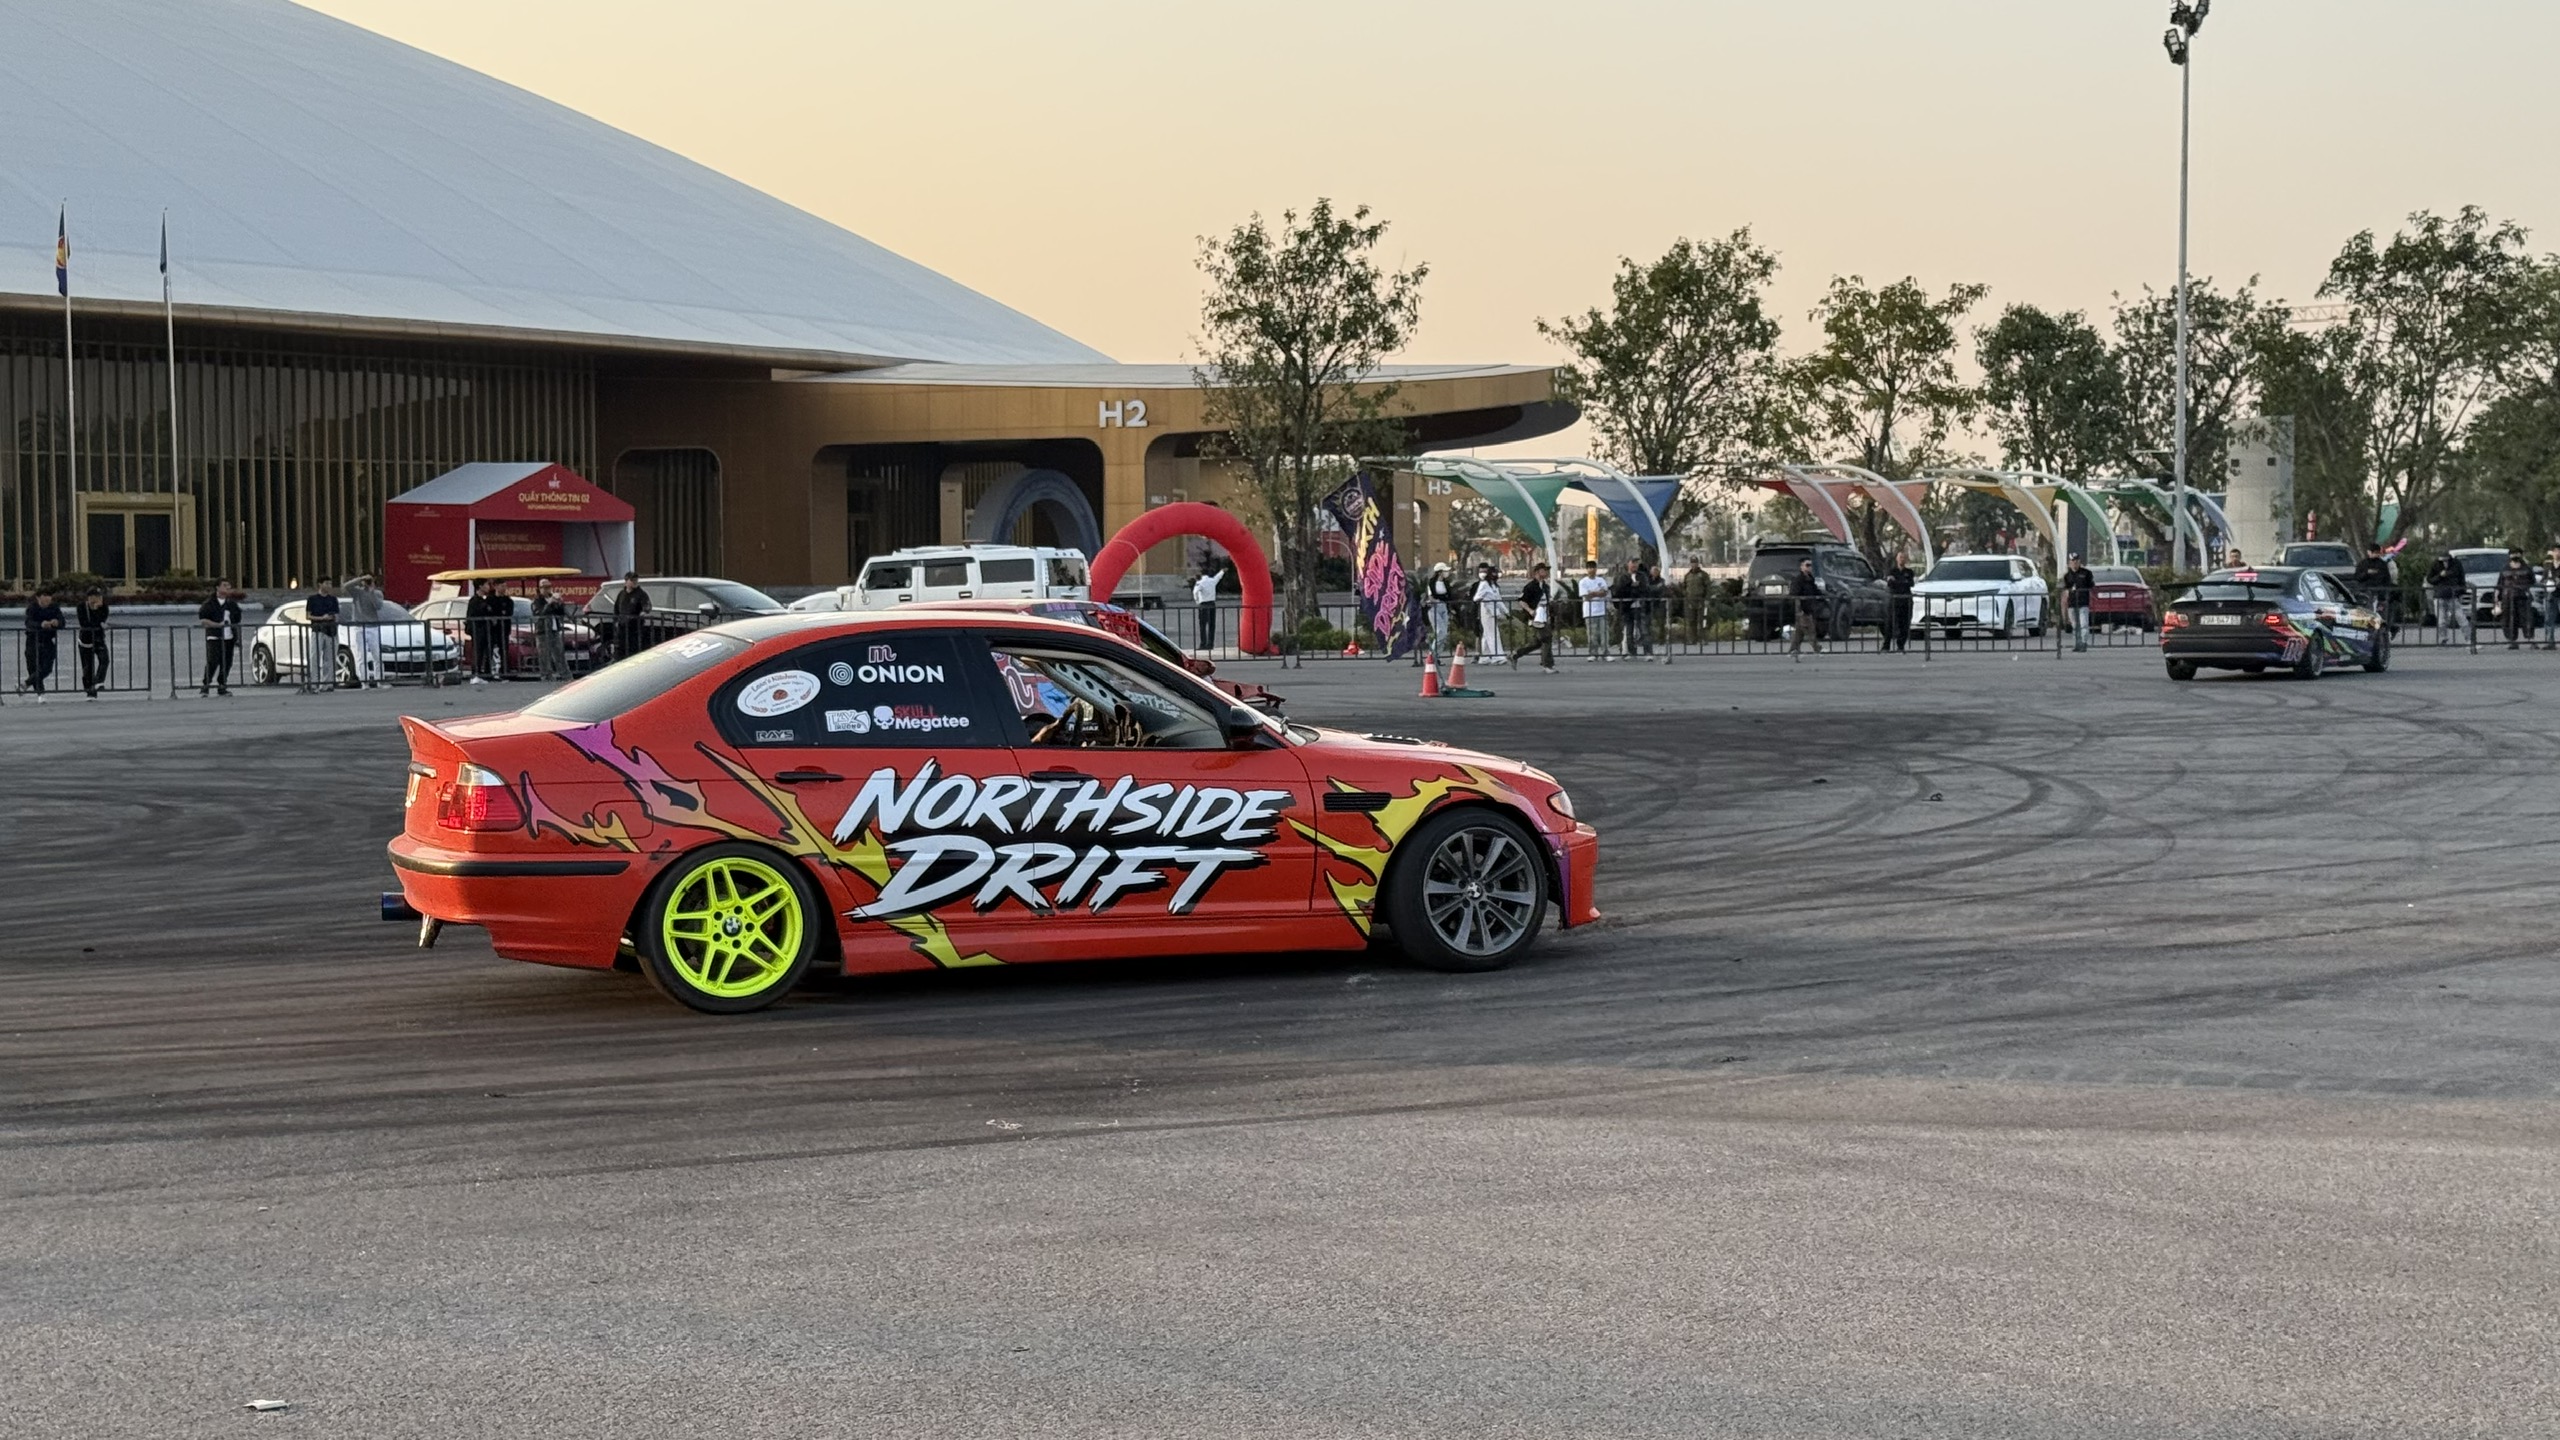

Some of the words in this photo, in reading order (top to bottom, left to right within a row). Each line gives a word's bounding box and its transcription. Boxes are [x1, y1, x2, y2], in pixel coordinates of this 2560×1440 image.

[1099, 399, 1149, 429] H2
[1428, 480, 1453, 496] H3
[858, 665, 945, 683] ONION
[894, 704, 939, 718] SKULL
[895, 715, 970, 732] Megatee
[756, 729, 795, 742] RAYS
[832, 756, 1291, 846] NORTHSIDE
[841, 834, 1266, 919] DRIFT
